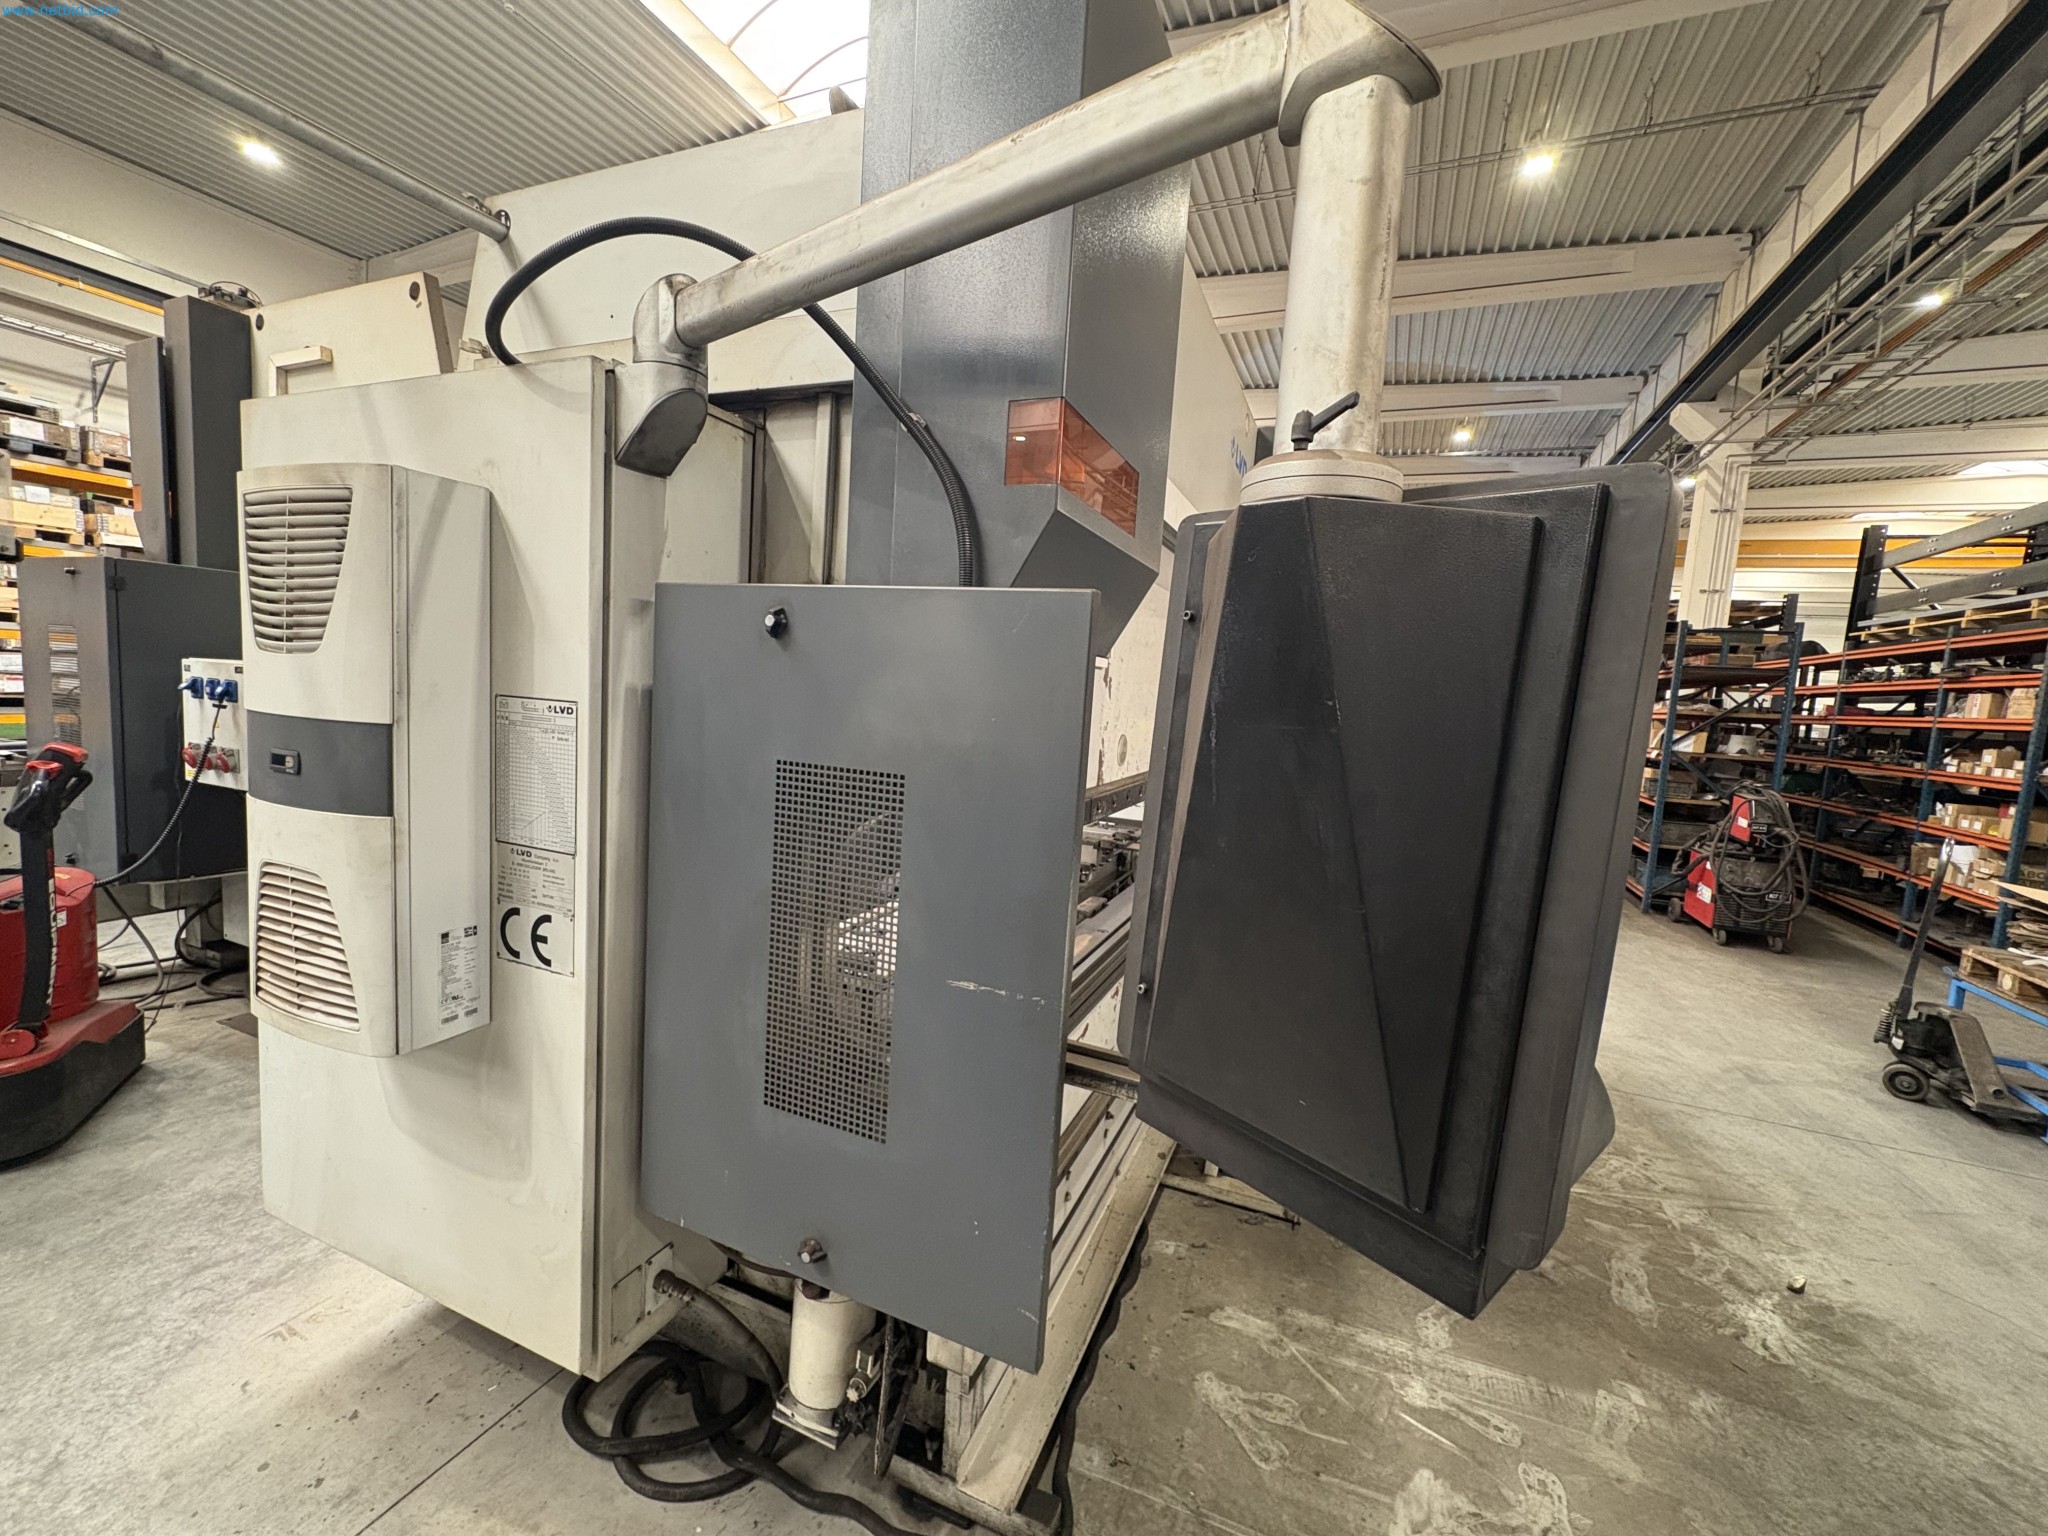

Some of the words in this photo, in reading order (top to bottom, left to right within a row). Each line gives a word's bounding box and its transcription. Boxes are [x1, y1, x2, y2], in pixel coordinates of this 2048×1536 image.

[553, 705, 574, 715] LVD
[516, 848, 532, 858] LVD
[45, 878, 58, 1006] EQUIPMENT
